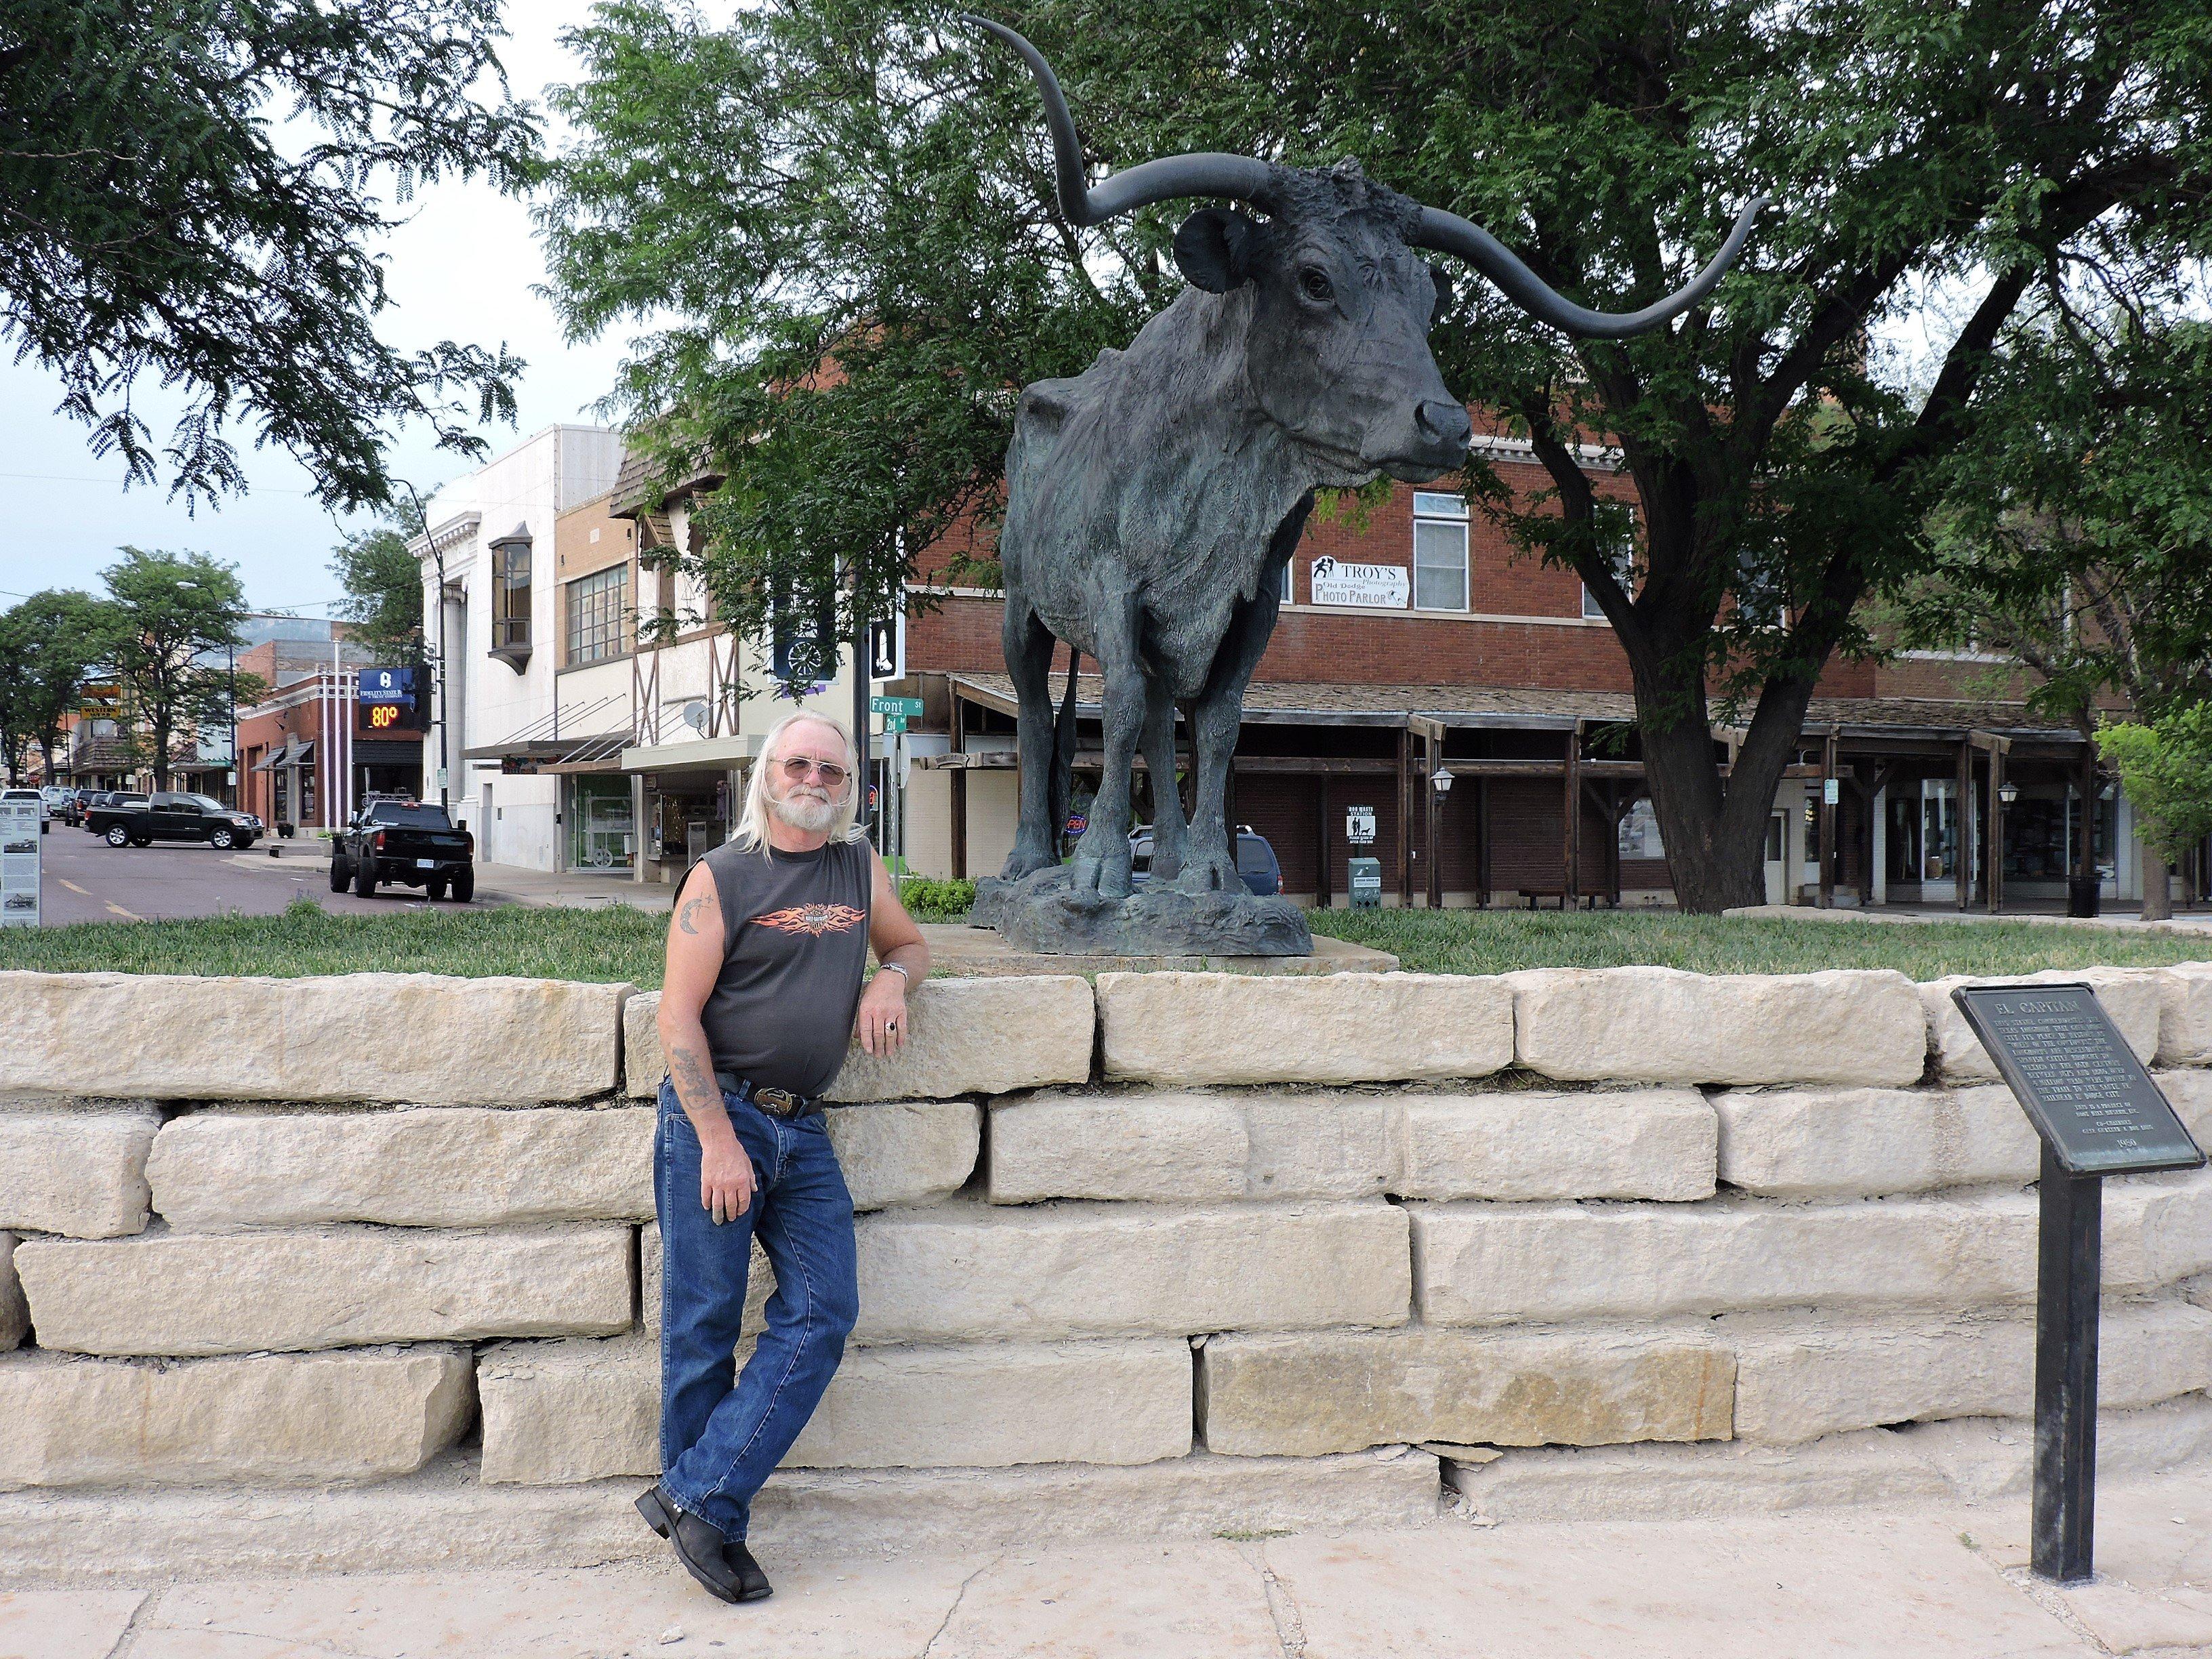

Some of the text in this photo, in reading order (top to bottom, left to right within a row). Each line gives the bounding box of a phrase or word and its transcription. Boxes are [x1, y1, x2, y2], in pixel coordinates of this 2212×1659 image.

[1341, 565, 1397, 580] TROY'S
[1361, 579, 1406, 588] Photography
[872, 698, 922, 712] Front St
[886, 718, 896, 731] 2nd
[1067, 819, 1086, 829] PEN
[1995, 1001, 2080, 1015] EL CAPITAN
